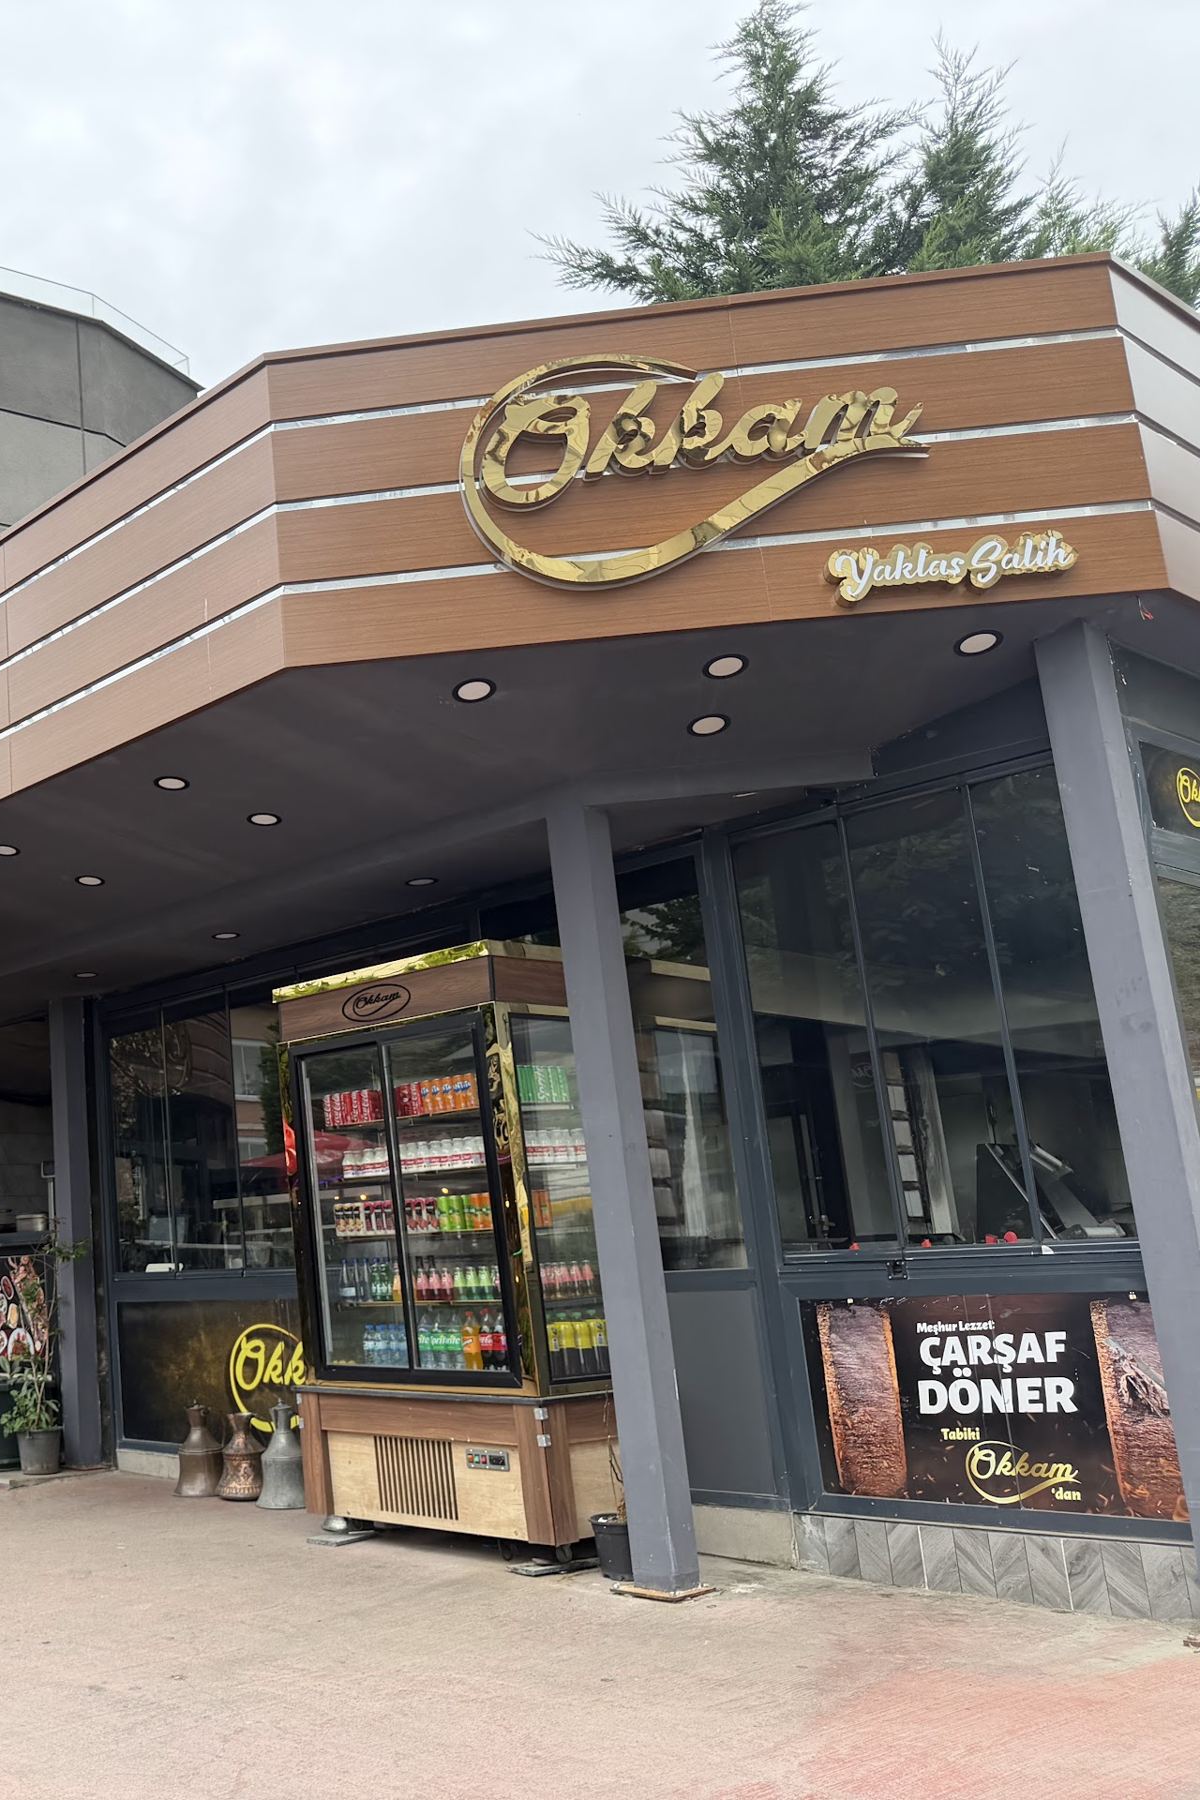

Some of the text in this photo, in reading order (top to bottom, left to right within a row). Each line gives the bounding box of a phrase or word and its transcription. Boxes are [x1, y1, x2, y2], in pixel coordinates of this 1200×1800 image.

[834, 535, 1077, 600] Yaklaş Salih
[356, 991, 401, 1009] Okkam
[916, 1320, 957, 1336] Meşhur
[235, 1336, 306, 1391] Okk
[919, 1330, 1067, 1375] ÇARŞAF
[917, 1367, 1079, 1415] DÖNER
